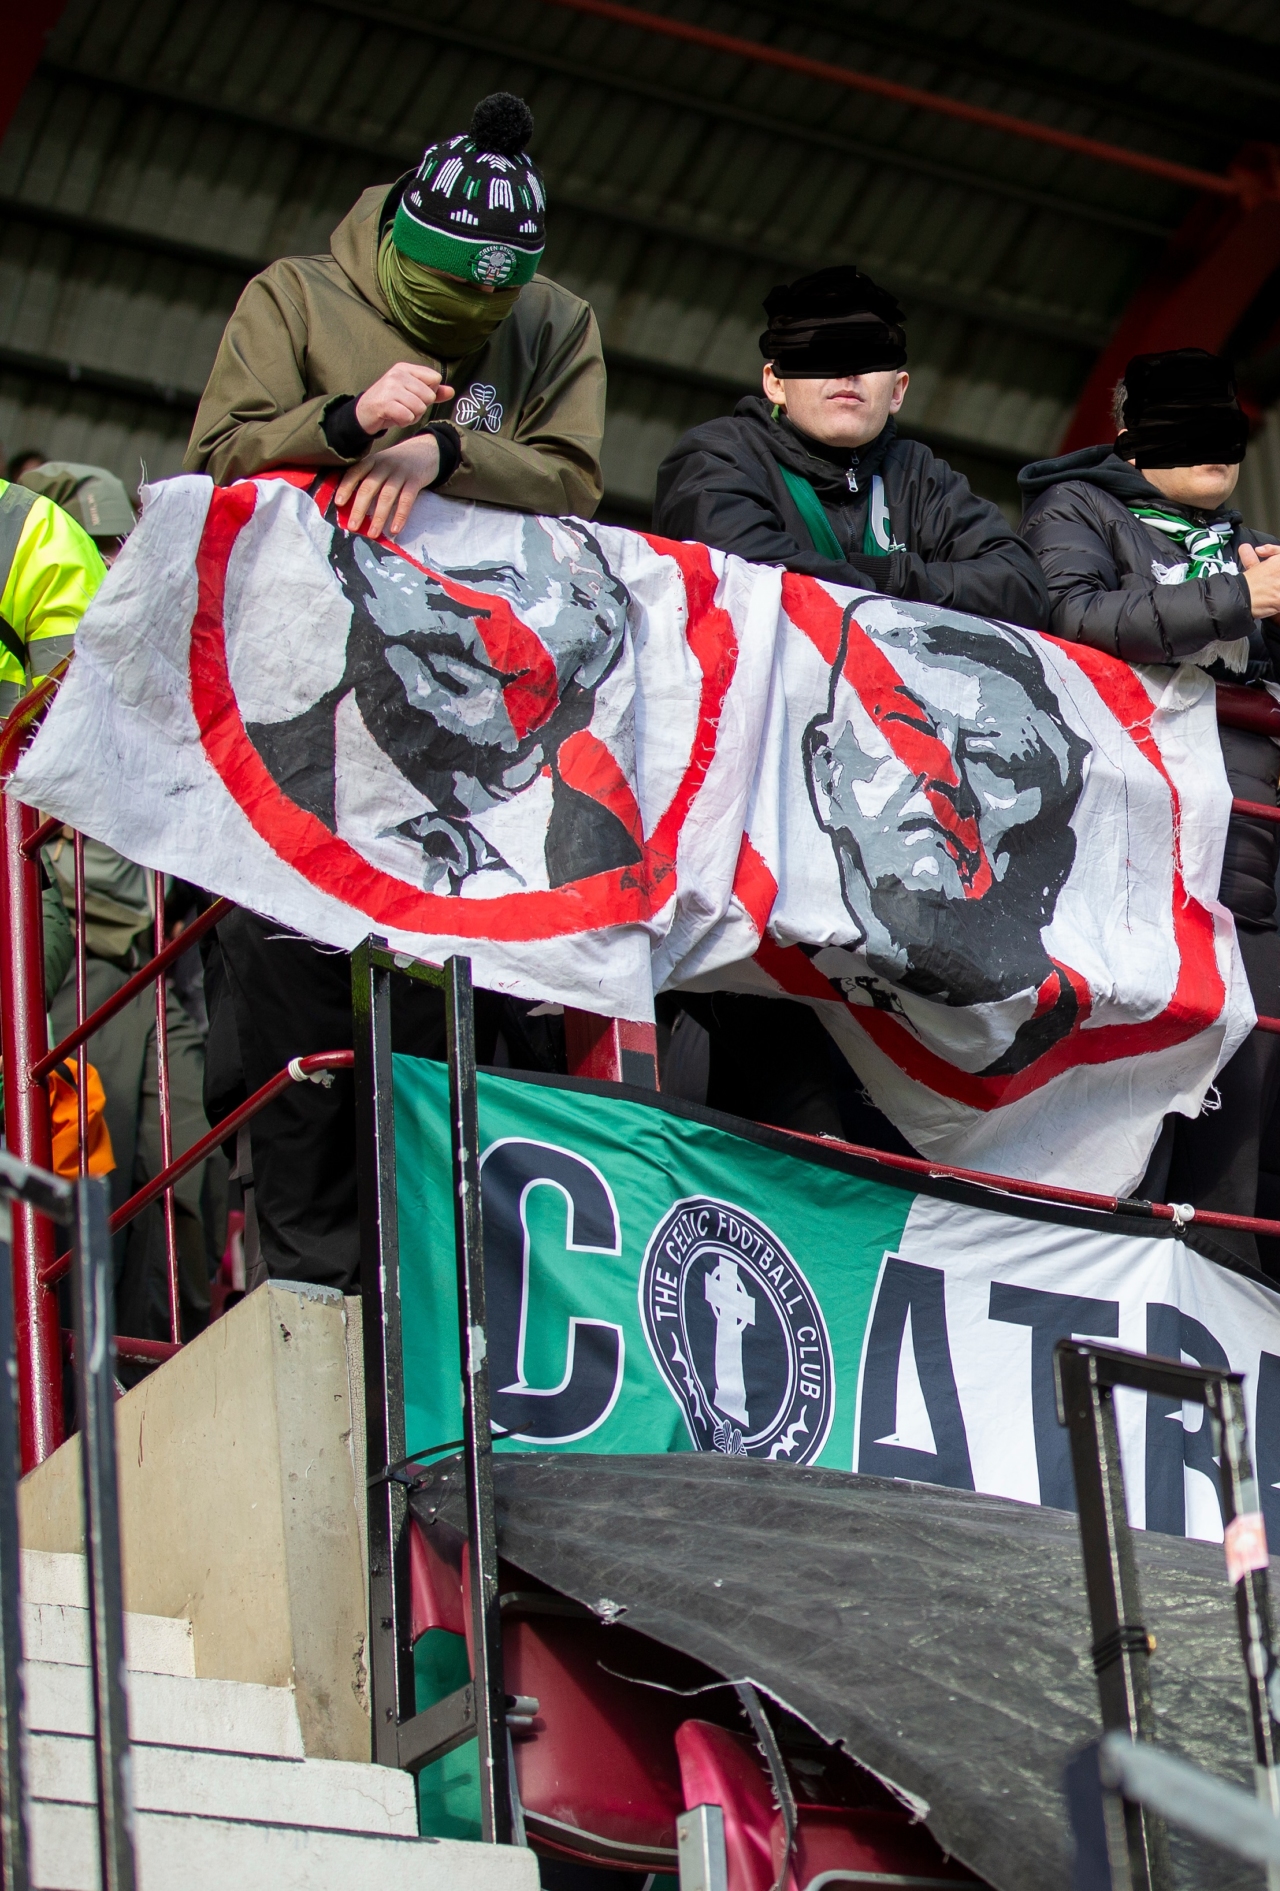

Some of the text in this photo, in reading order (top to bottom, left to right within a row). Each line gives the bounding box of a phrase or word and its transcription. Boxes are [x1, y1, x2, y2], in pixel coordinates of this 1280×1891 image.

[655, 1210, 821, 1399] THE CELTIC FOOTBALL CLUB
